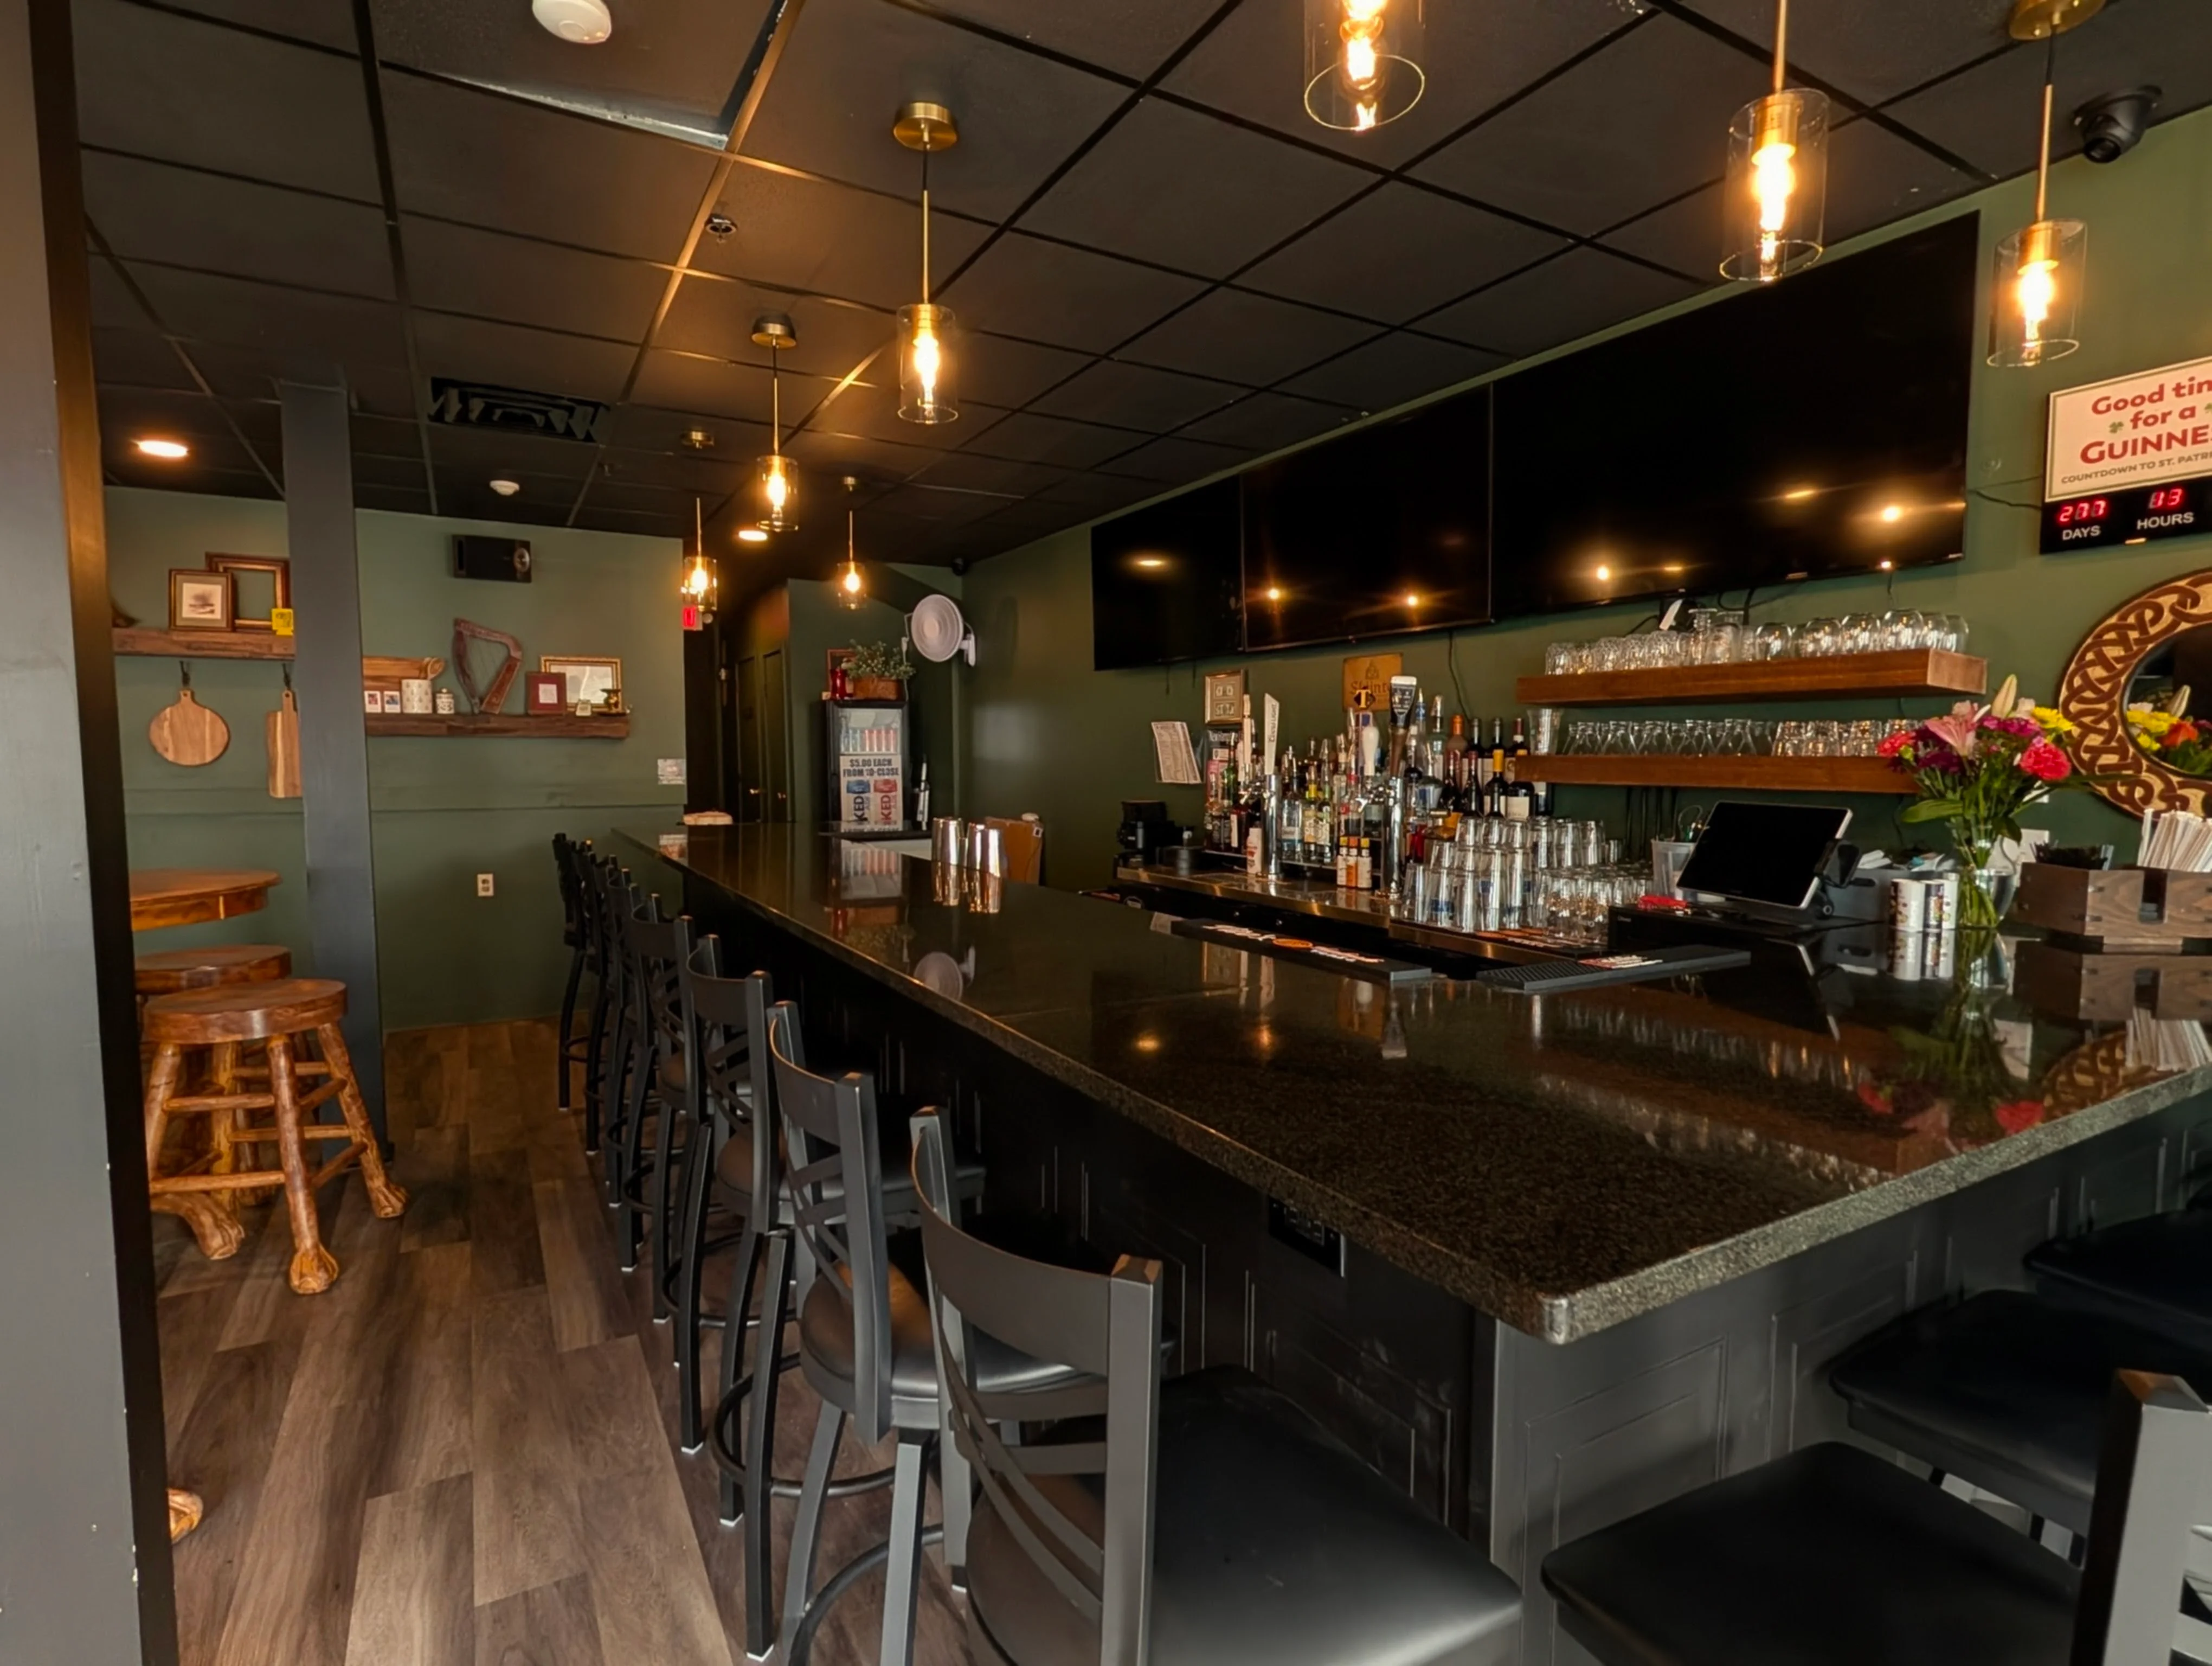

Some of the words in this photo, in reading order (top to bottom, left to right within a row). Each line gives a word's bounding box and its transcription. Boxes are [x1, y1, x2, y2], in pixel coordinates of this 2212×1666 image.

[2092, 383, 2165, 415] Good
[2130, 410, 2172, 430] for
[2178, 406, 2196, 420] a
[2080, 425, 2212, 464] GUINNE
[2061, 465, 2137, 484] COUNTDOWN
[2138, 461, 2156, 470] TO
[2158, 458, 2175, 467] ST.
[2059, 500, 2106, 522] 277
[2152, 488, 2183, 508] 13
[2136, 512, 2195, 530] HOURS
[2062, 526, 2101, 541] DAYS
[843, 768, 864, 777] FROM
[850, 758, 872, 767] $5.00
[873, 758, 892, 766] EACH
